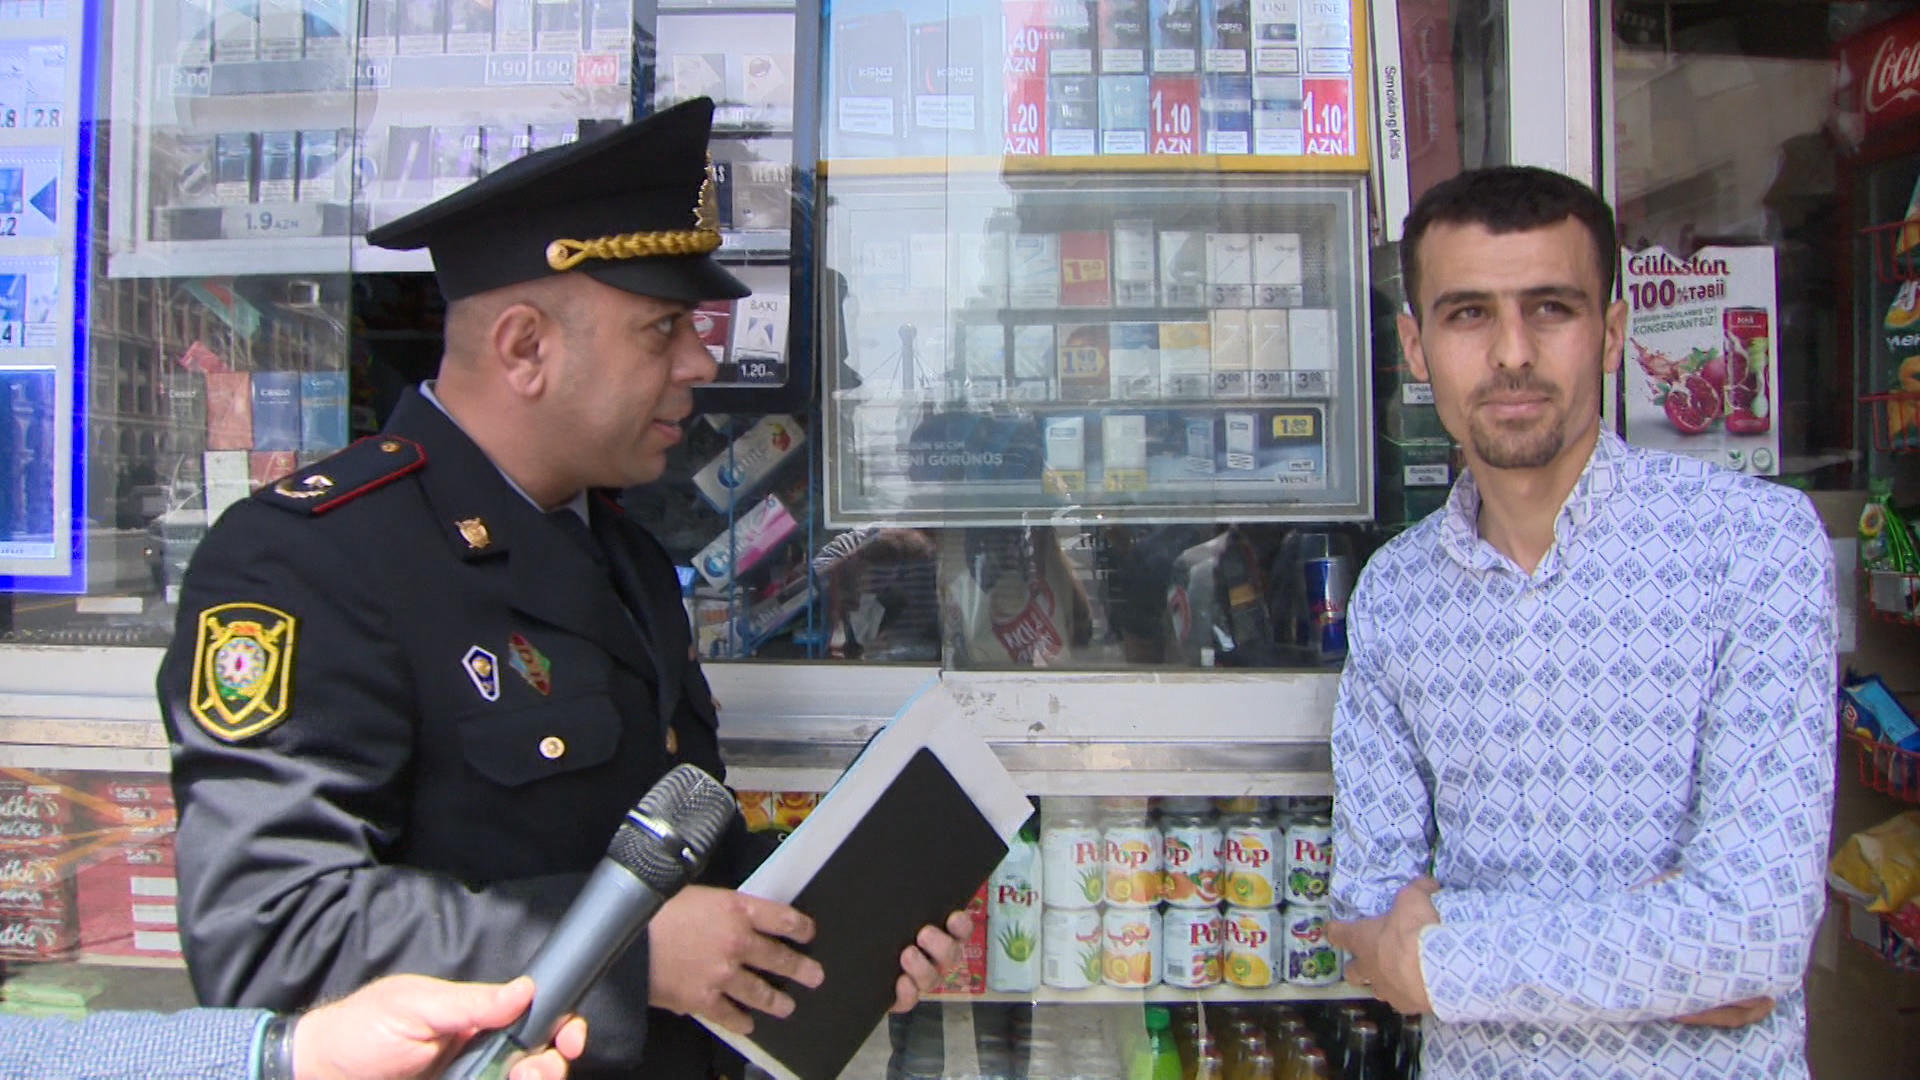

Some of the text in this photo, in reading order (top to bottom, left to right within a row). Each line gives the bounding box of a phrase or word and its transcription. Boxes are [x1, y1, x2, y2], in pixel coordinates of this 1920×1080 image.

[1004, 138, 1039, 154] AZN
[1155, 138, 1192, 154] AZN
[1306, 138, 1342, 154] AZN
[1104, 841, 1149, 869] Pop
[1226, 840, 1270, 869] Pop
[998, 884, 1039, 907] Pop
[1225, 919, 1268, 948] Pop
